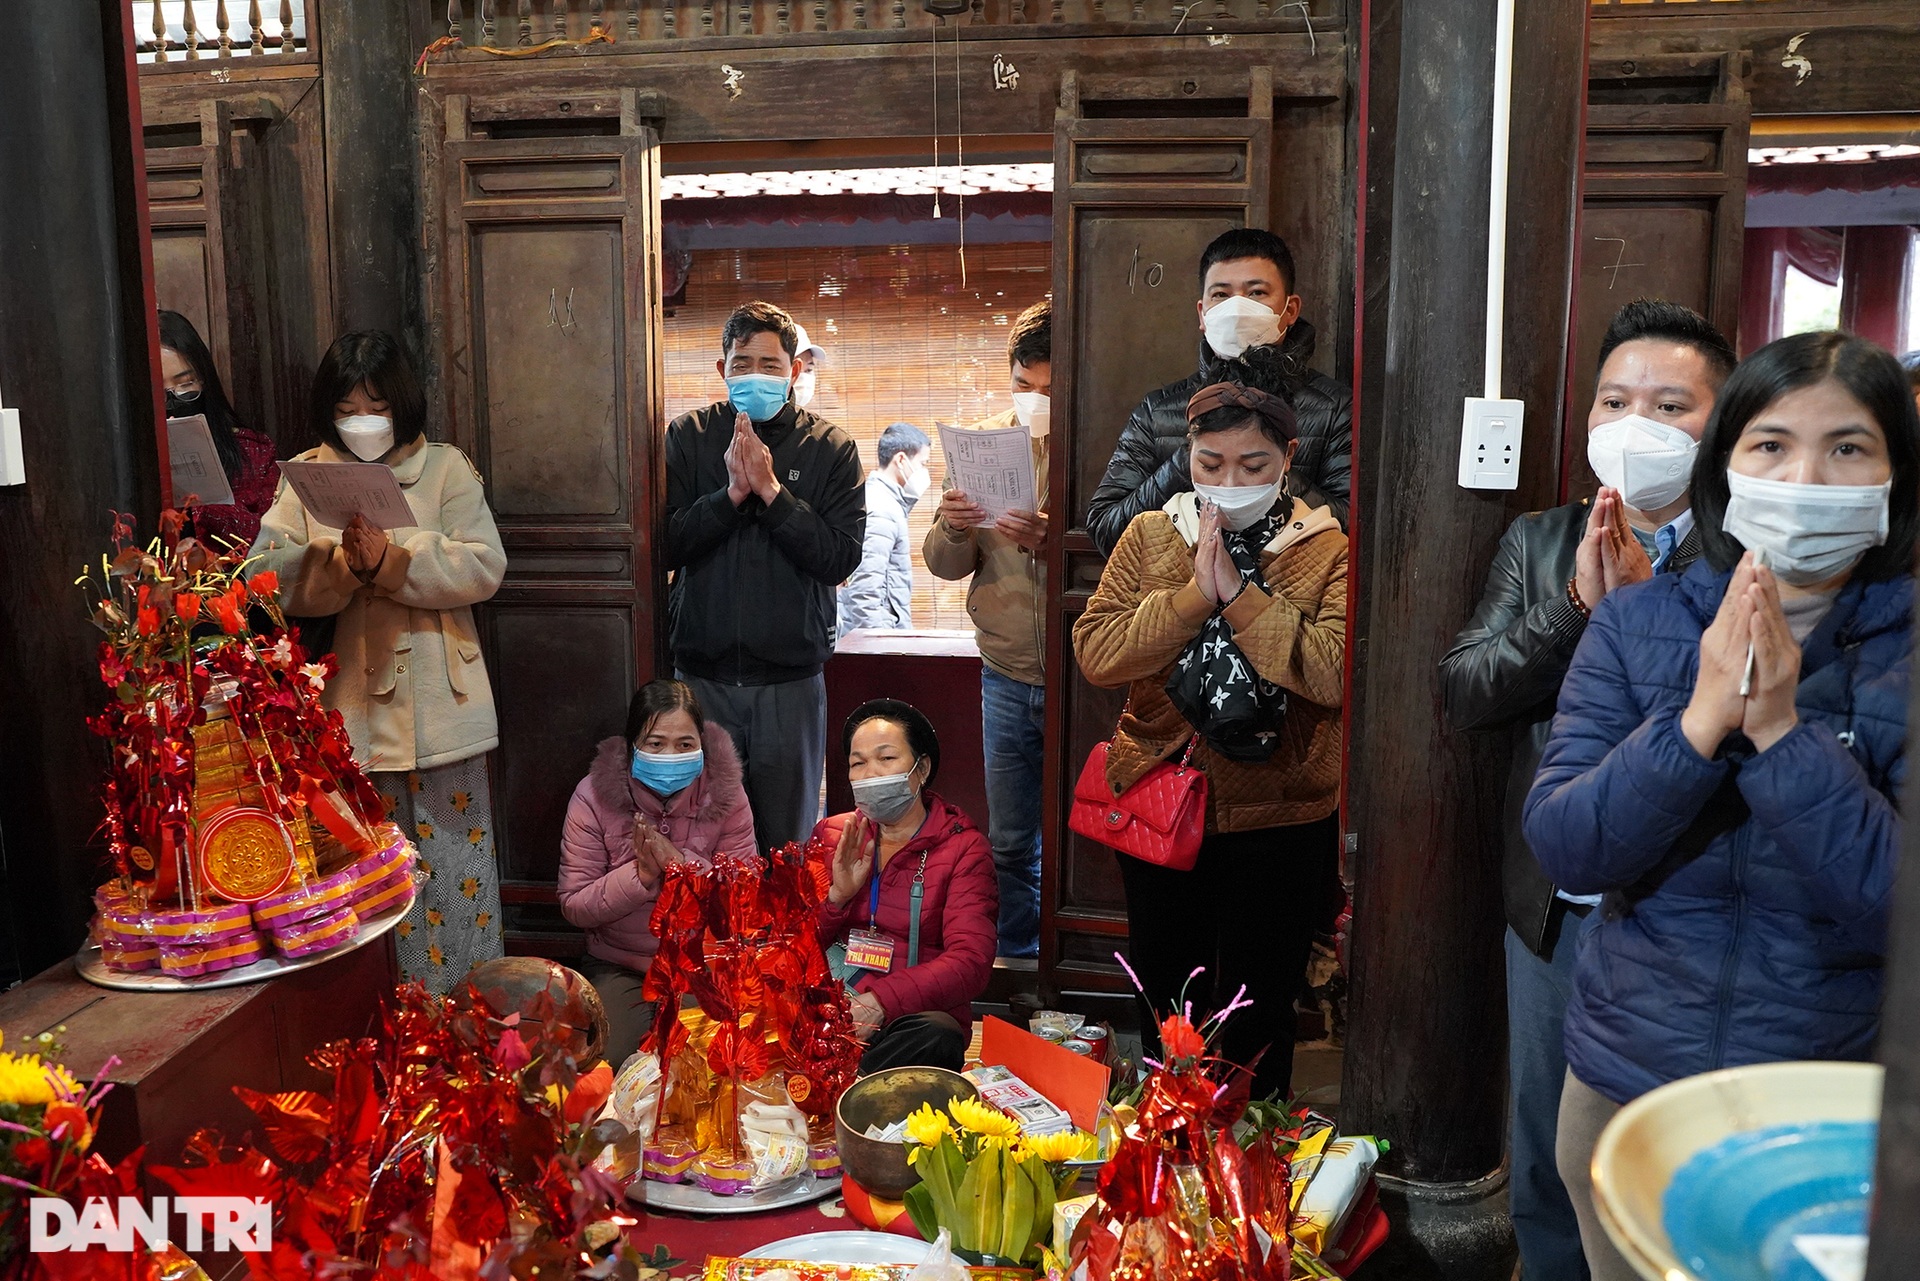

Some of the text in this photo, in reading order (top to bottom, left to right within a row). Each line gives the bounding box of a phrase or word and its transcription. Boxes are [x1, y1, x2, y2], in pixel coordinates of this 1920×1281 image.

[1129, 248, 1164, 294] 10
[1594, 236, 1645, 290] 7
[847, 948, 864, 963] THỦ
[864, 953, 890, 968] NHANG
